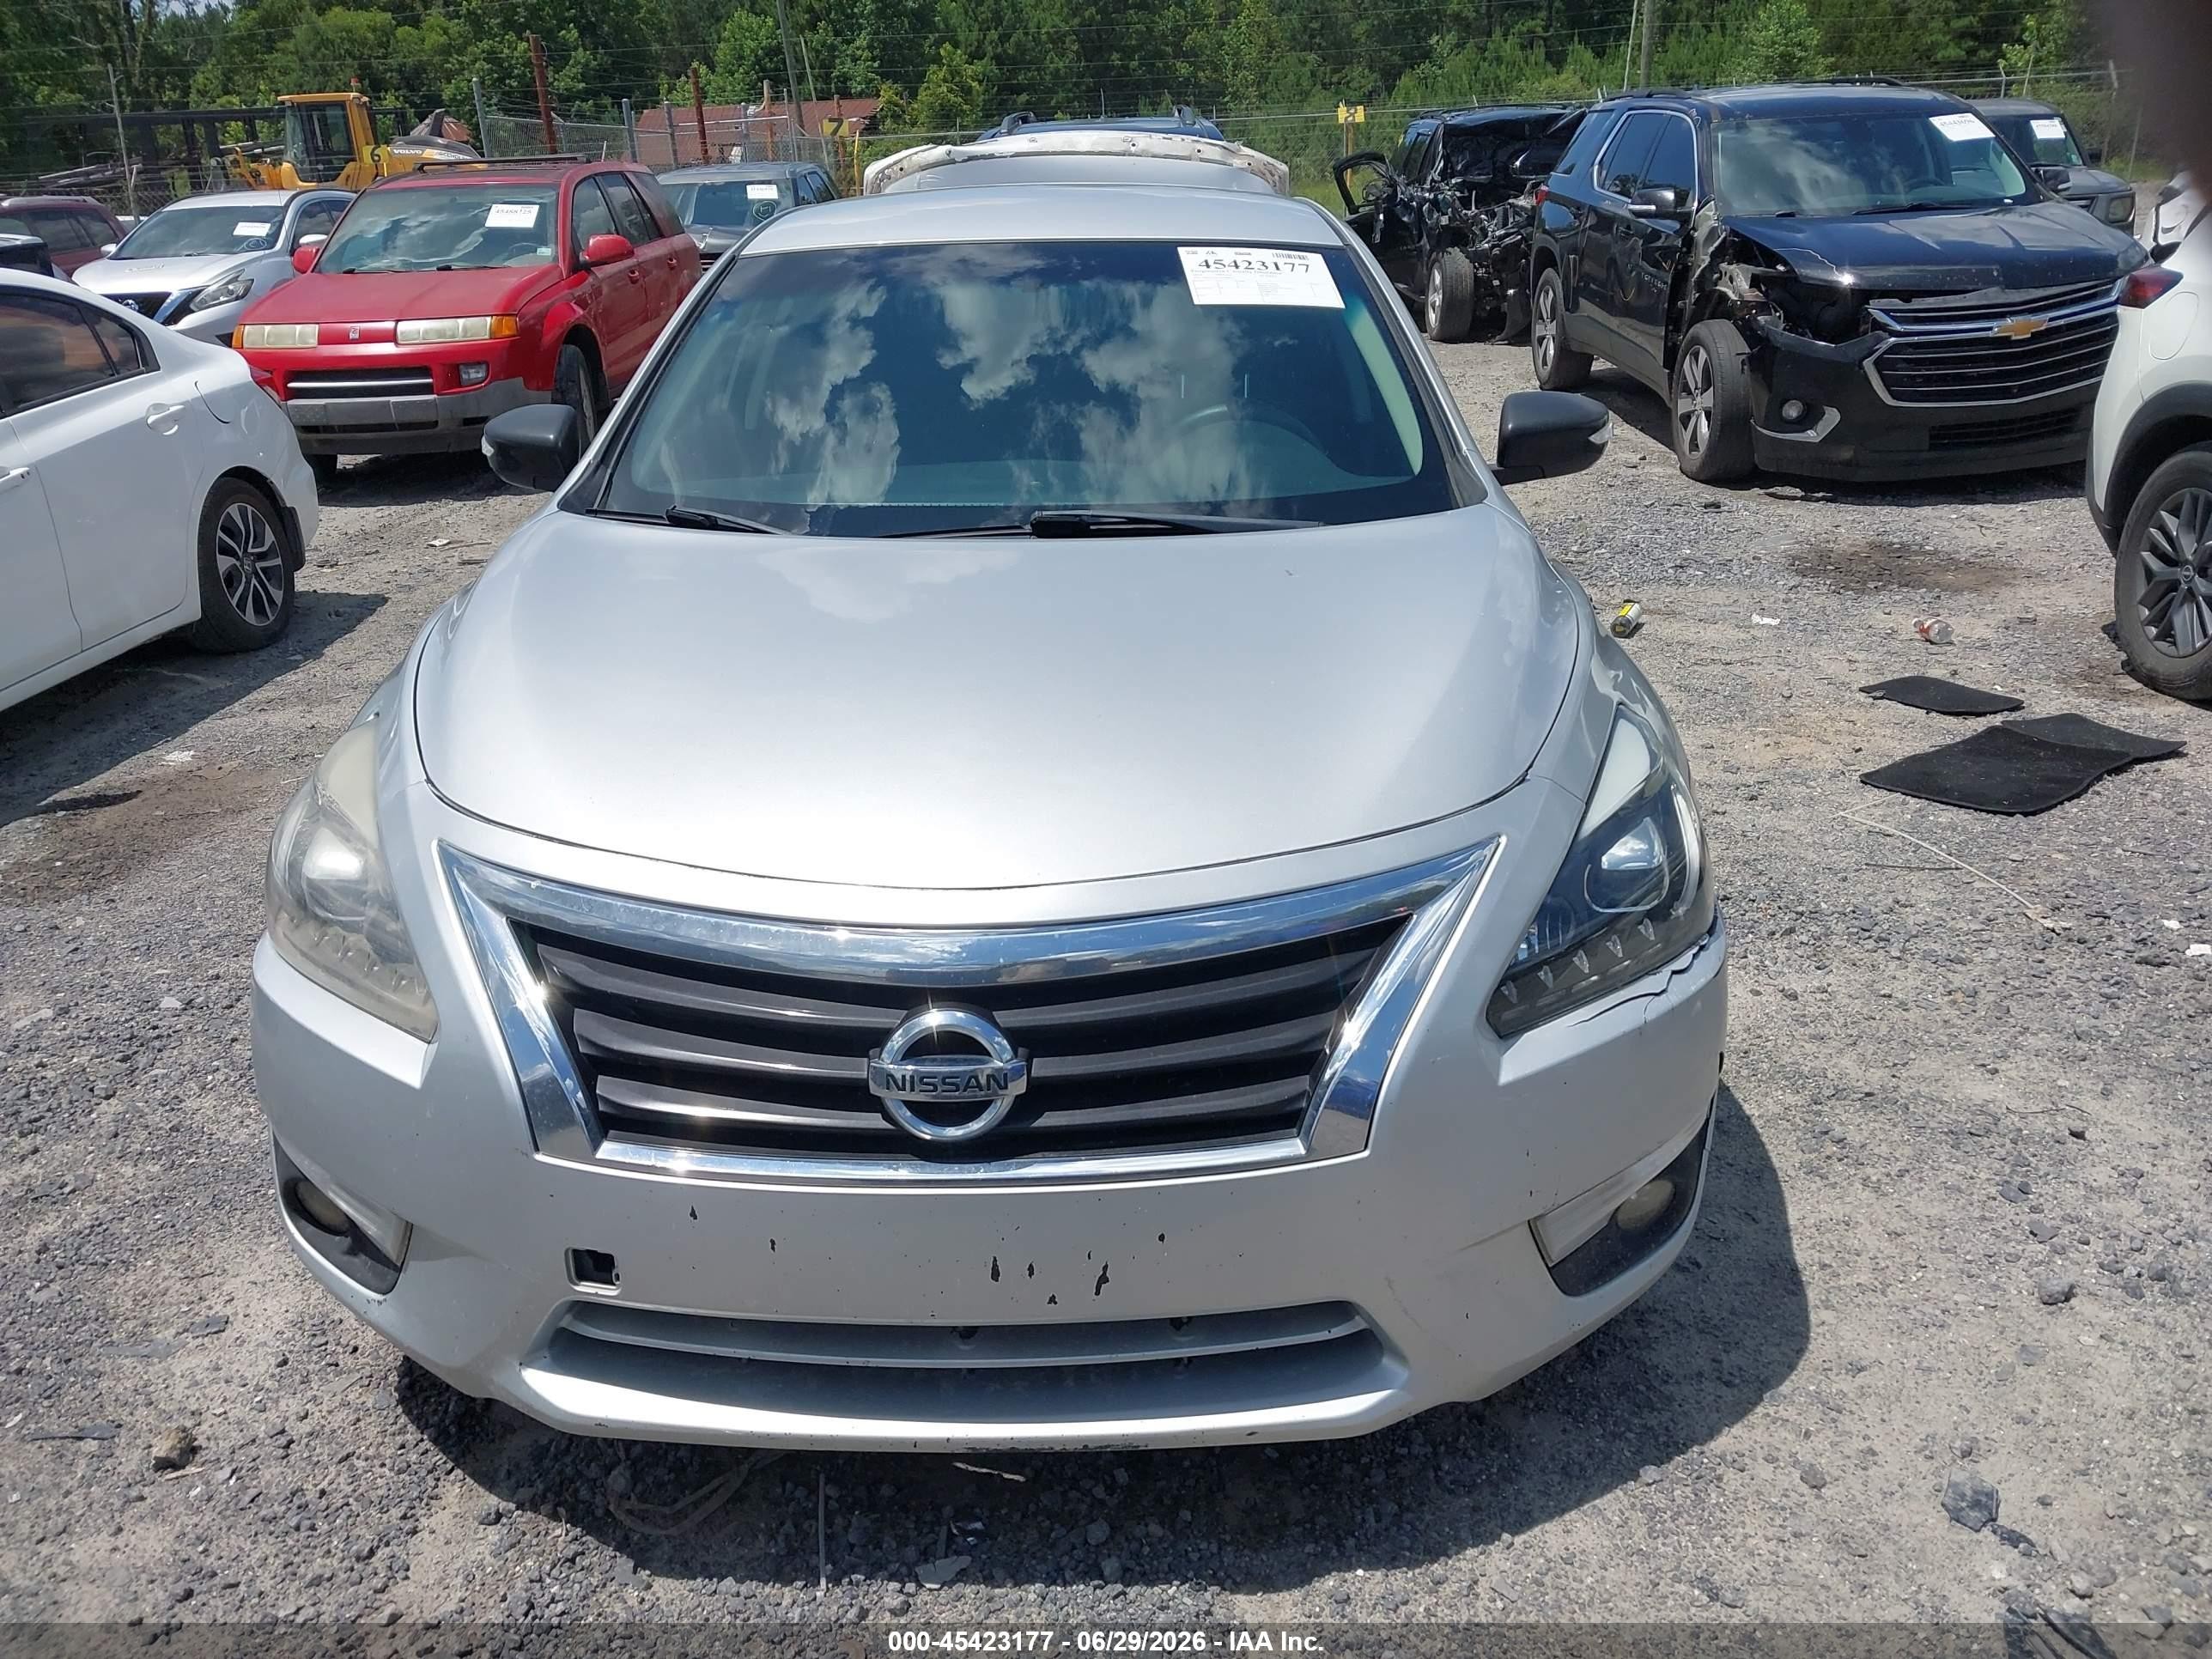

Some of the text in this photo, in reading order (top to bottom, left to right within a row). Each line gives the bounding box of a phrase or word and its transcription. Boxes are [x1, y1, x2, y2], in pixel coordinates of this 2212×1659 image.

[828, 118, 844, 136] 7
[370, 144, 381, 163] 6
[1197, 258, 1310, 274] 45423177
[885, 1072, 1008, 1093] NISSAN
